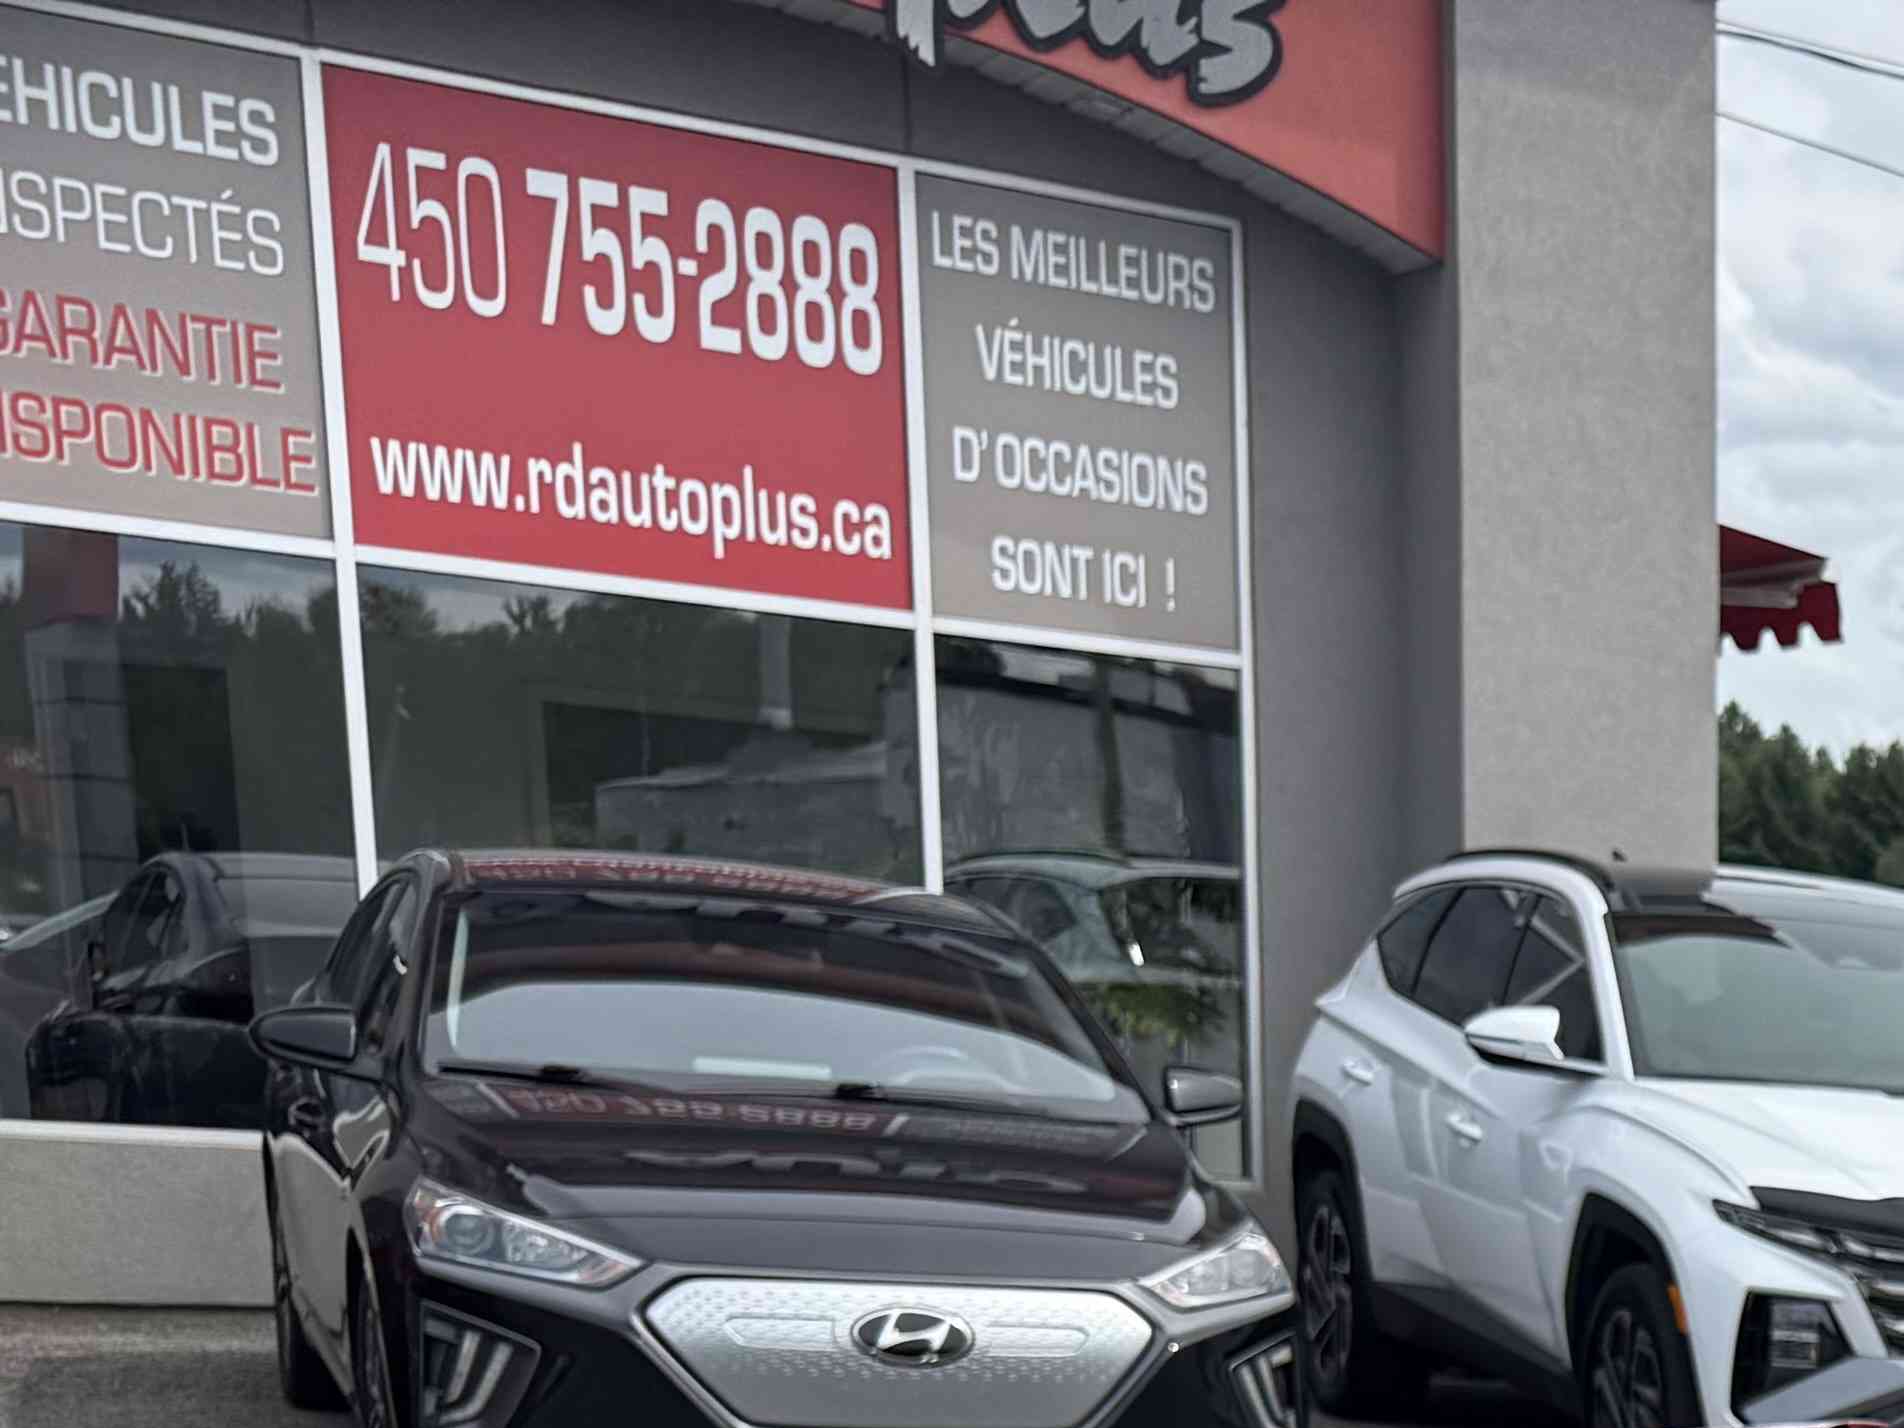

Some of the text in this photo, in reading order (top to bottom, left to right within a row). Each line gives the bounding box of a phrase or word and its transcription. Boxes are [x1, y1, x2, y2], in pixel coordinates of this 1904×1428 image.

[0, 54, 280, 166] HICULES
[0, 168, 284, 276] SPECTÉS
[356, 141, 884, 376] 450 755-2888
[931, 210, 1217, 313] LES MEILLEURS
[0, 287, 285, 394] ARANTIE
[974, 316, 1180, 410] VÉHICULES
[369, 436, 893, 560] www.rdautoplus.ca
[991, 535, 1177, 613] SONT ICI !
